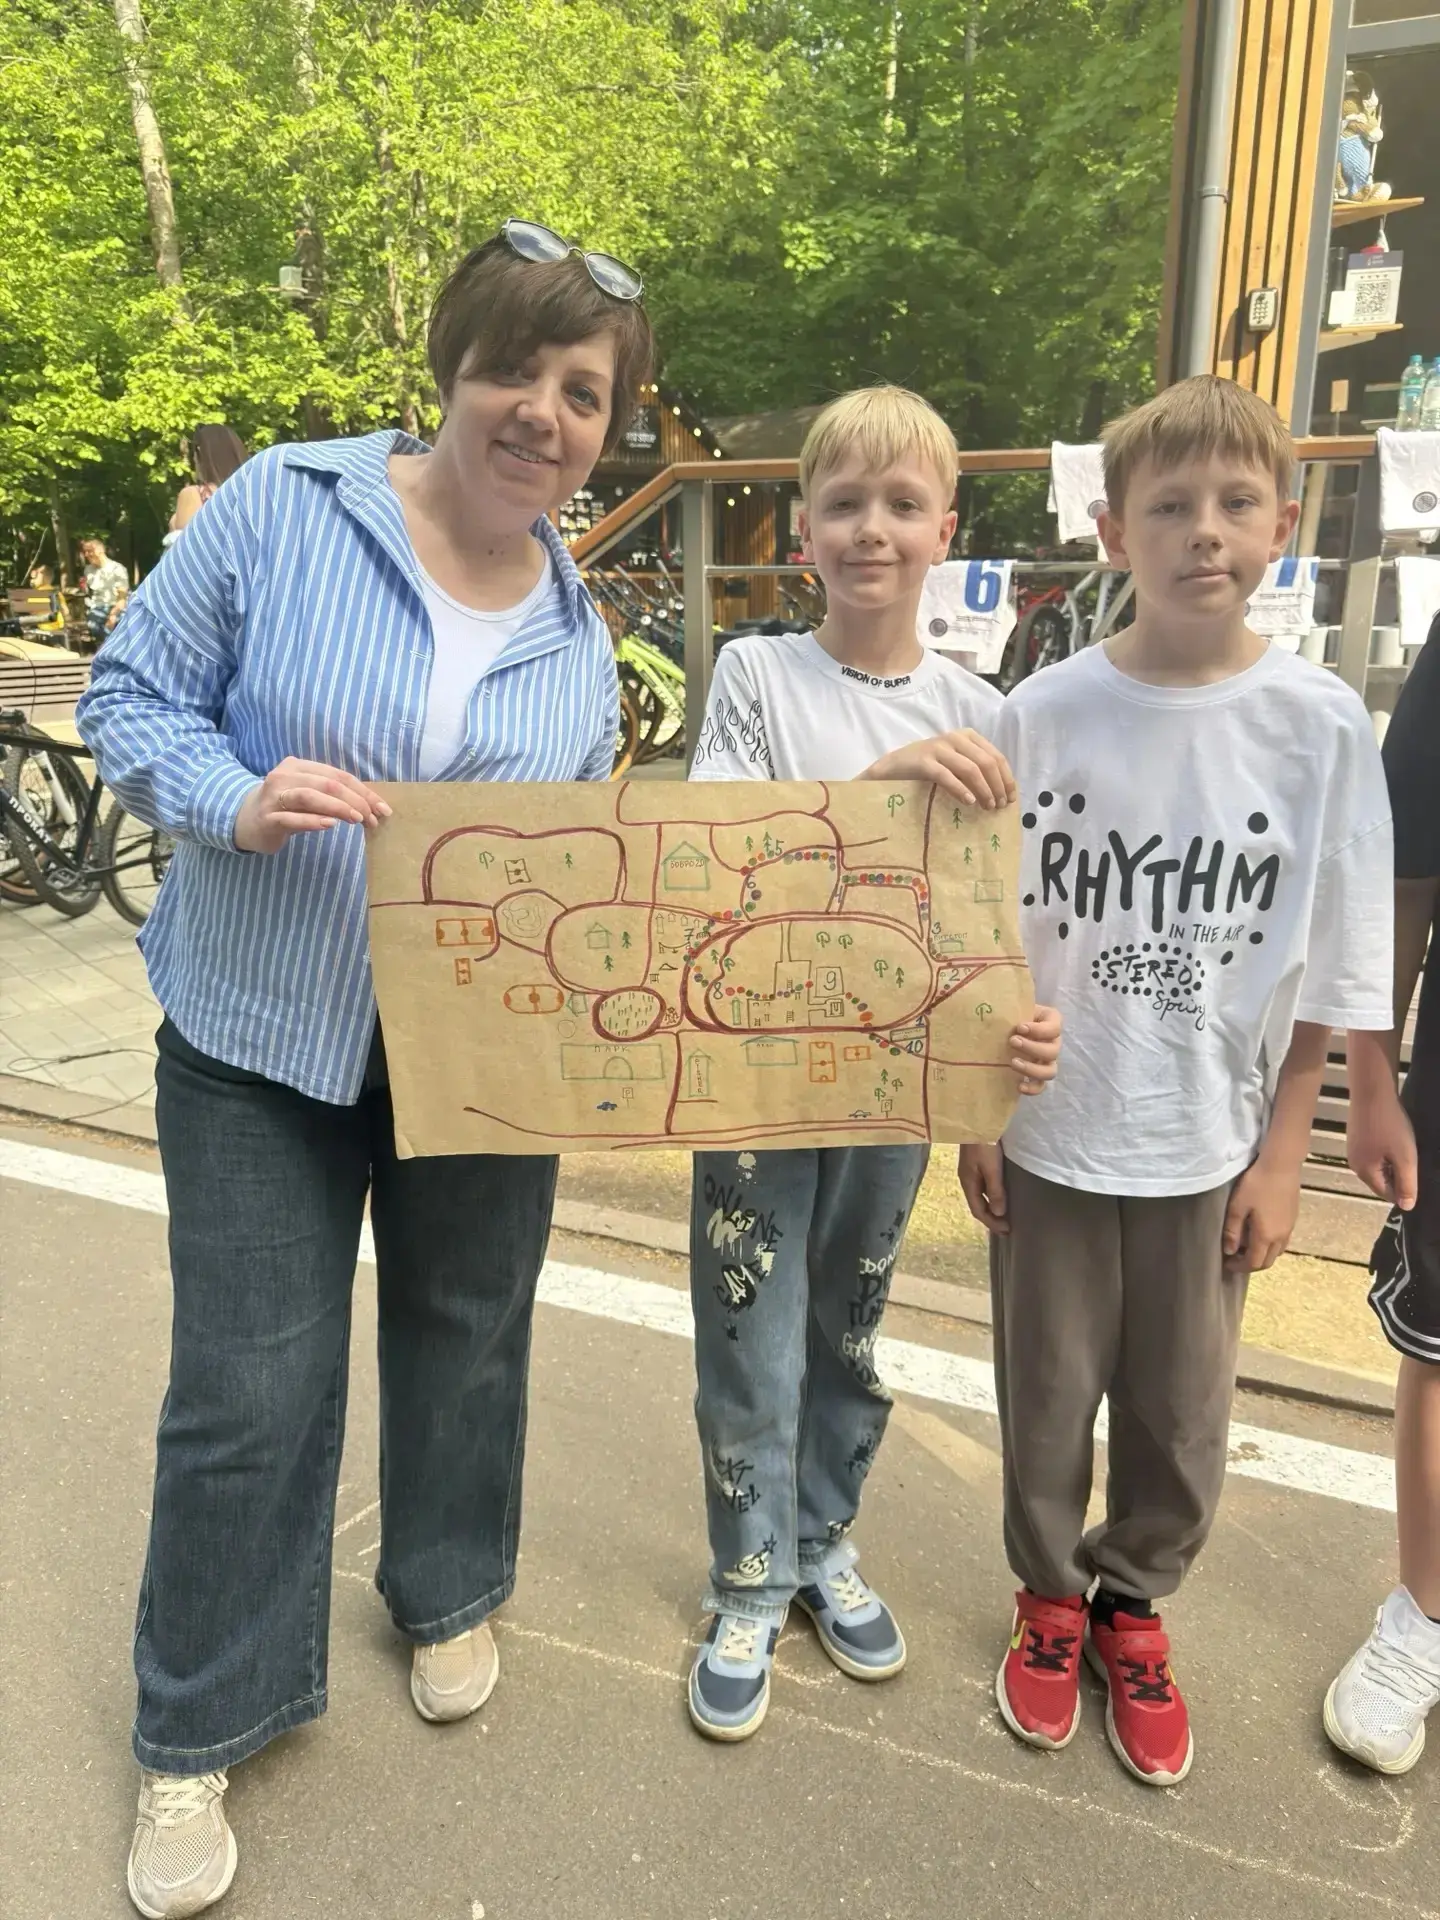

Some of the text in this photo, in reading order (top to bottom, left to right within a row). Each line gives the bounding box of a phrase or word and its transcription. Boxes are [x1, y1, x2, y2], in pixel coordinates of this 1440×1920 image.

[964, 560, 1002, 612] 6
[841, 665, 911, 688] VISION OF SUPER
[9, 796, 53, 843] ПРОКАТ
[774, 839, 784, 855] 5
[746, 874, 756, 889] 6
[1041, 829, 1280, 934] RHYTHM
[684, 928, 694, 941] 7
[931, 921, 941, 935] 3
[1169, 923, 1244, 944] IN THE AIR
[823, 970, 837, 991] 9
[948, 968, 961, 982] 2
[1107, 955, 1192, 987] STEREO
[713, 981, 723, 1000] 8
[1152, 990, 1206, 1031] Spring
[905, 1039, 923, 1054] 10
